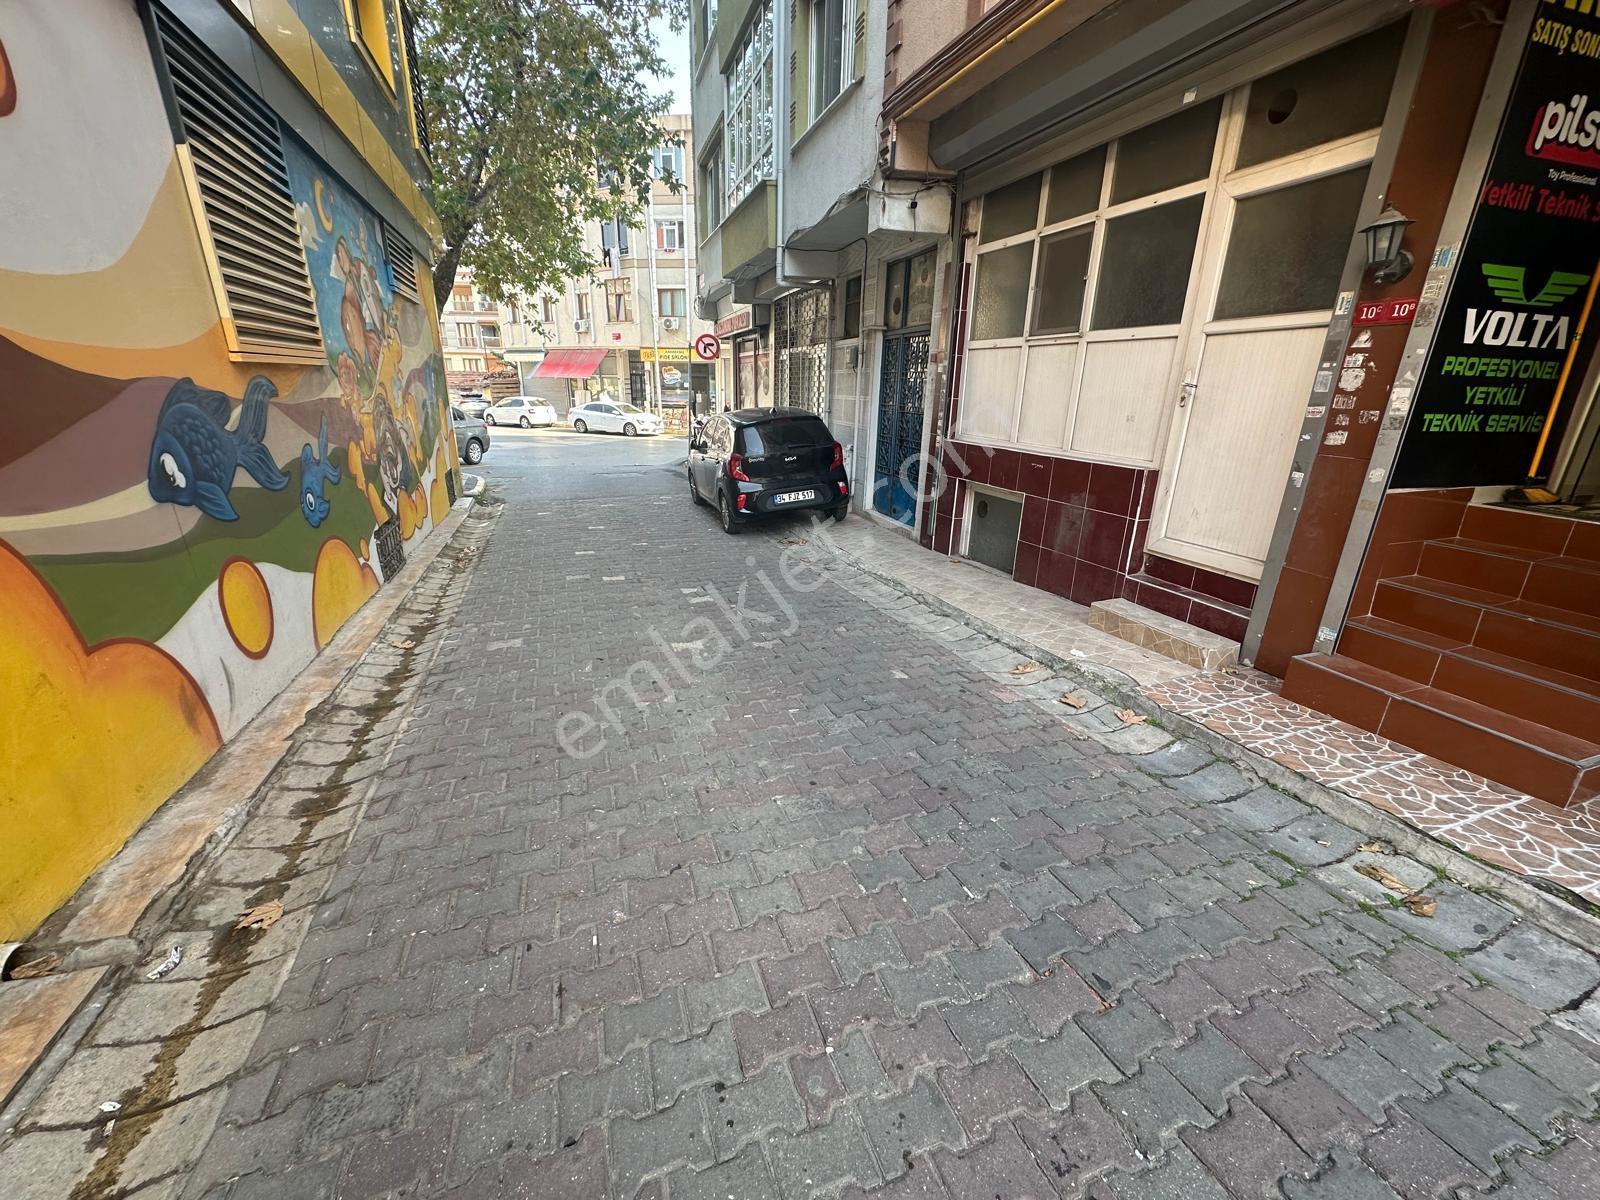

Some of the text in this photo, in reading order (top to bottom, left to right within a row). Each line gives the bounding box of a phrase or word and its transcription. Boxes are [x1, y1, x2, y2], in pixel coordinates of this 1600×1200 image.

[1532, 17, 1572, 55] SATIŞ
[1547, 168, 1560, 182] Toy
[1536, 187, 1592, 221] Teknik
[1463, 308, 1570, 350] VOLTA
[1441, 356, 1560, 380] PROFESYONEL
[1464, 383, 1527, 406] YETKİLİ
[1422, 409, 1545, 433] TEKNİK SERVİS
[788, 492, 800, 500] FJZ
[801, 490, 813, 498] 517
